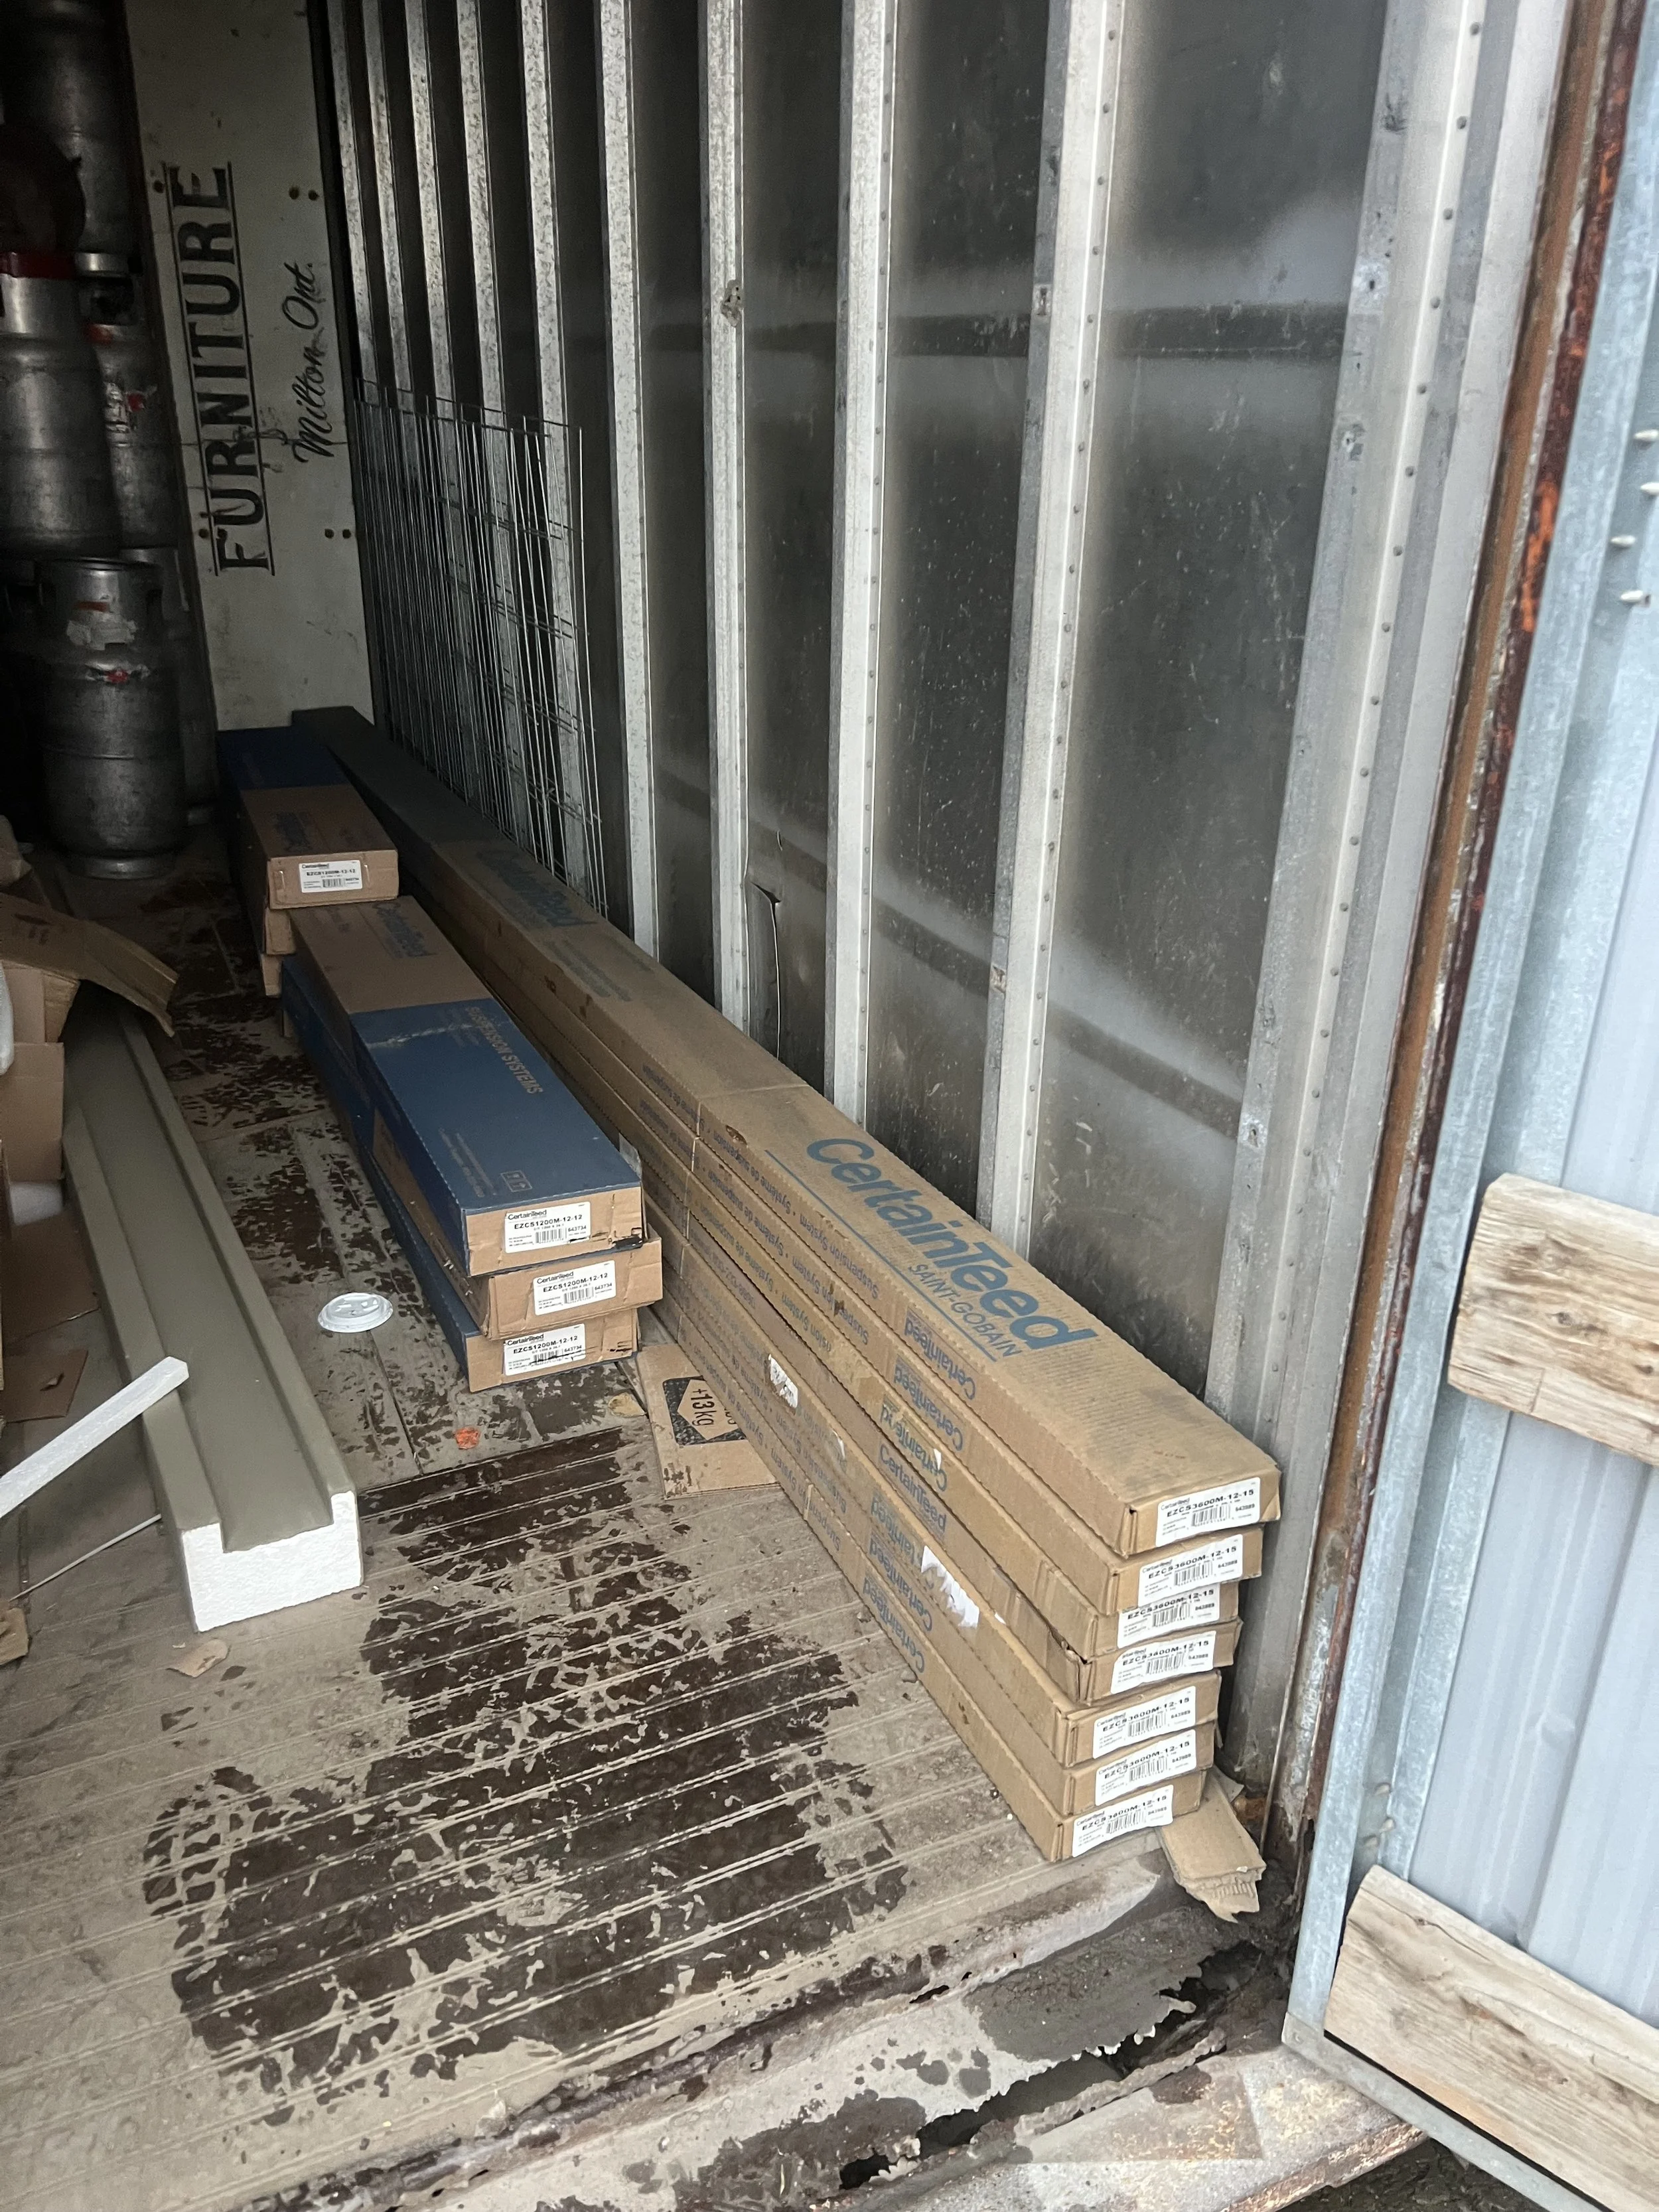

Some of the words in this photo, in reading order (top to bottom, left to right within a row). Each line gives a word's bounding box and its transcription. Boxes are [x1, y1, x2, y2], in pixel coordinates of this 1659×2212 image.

[282, 261, 326, 331] Ont.
[168, 166, 271, 572] FURNITURE
[292, 329, 334, 463] Milton
[466, 1007, 513, 1054] SUSPENSION
[502, 1055, 543, 1094] SYSTEMS
[751, 1166, 759, 1181] de
[744, 1206, 753, 1222] de
[760, 1175, 791, 1215] Système
[508, 1210, 547, 1220] CertainTeed
[514, 1214, 583, 1229] EZCS1200M-12-12
[800, 1214, 828, 1250] System
[806, 1138, 1099, 1350] CertainTeed
[537, 1271, 574, 1284] CertainTeed
[543, 1273, 608, 1292] EZCS1200M-12-12
[792, 1256, 820, 1294] System
[830, 1244, 879, 1299] Suspension
[782, 1293, 809, 1331] System
[822, 1286, 869, 1345] Suspeion
[908, 1264, 1023, 1357] SAINT-GOBAIN
[507, 1333, 544, 1346] CertainTeed
[513, 1335, 578, 1354] EZCS1200M-12-12
[904, 1318, 975, 1400] CertainTeed
[691, 1388, 717, 1426] +13kg
[894, 1365, 963, 1451] CertainTeed
[880, 1443, 947, 1534] CertainTeed
[1167, 1489, 1254, 1518] EZCS3600M-12-15
[1148, 1546, 1237, 1580] EZCS3600M-12-15
[869, 1537, 933, 1631] CertainTeed
[1127, 1589, 1214, 1620] EZCS3600M-12-15
[864, 1577, 924, 1673] CertainTeed
[1102, 1697, 1190, 1733] EZCS3600M-12-15
[1104, 1741, 1190, 1779] EZCS3600M-12-15
[1082, 1795, 1167, 1831] EZCS3600M-12-15
